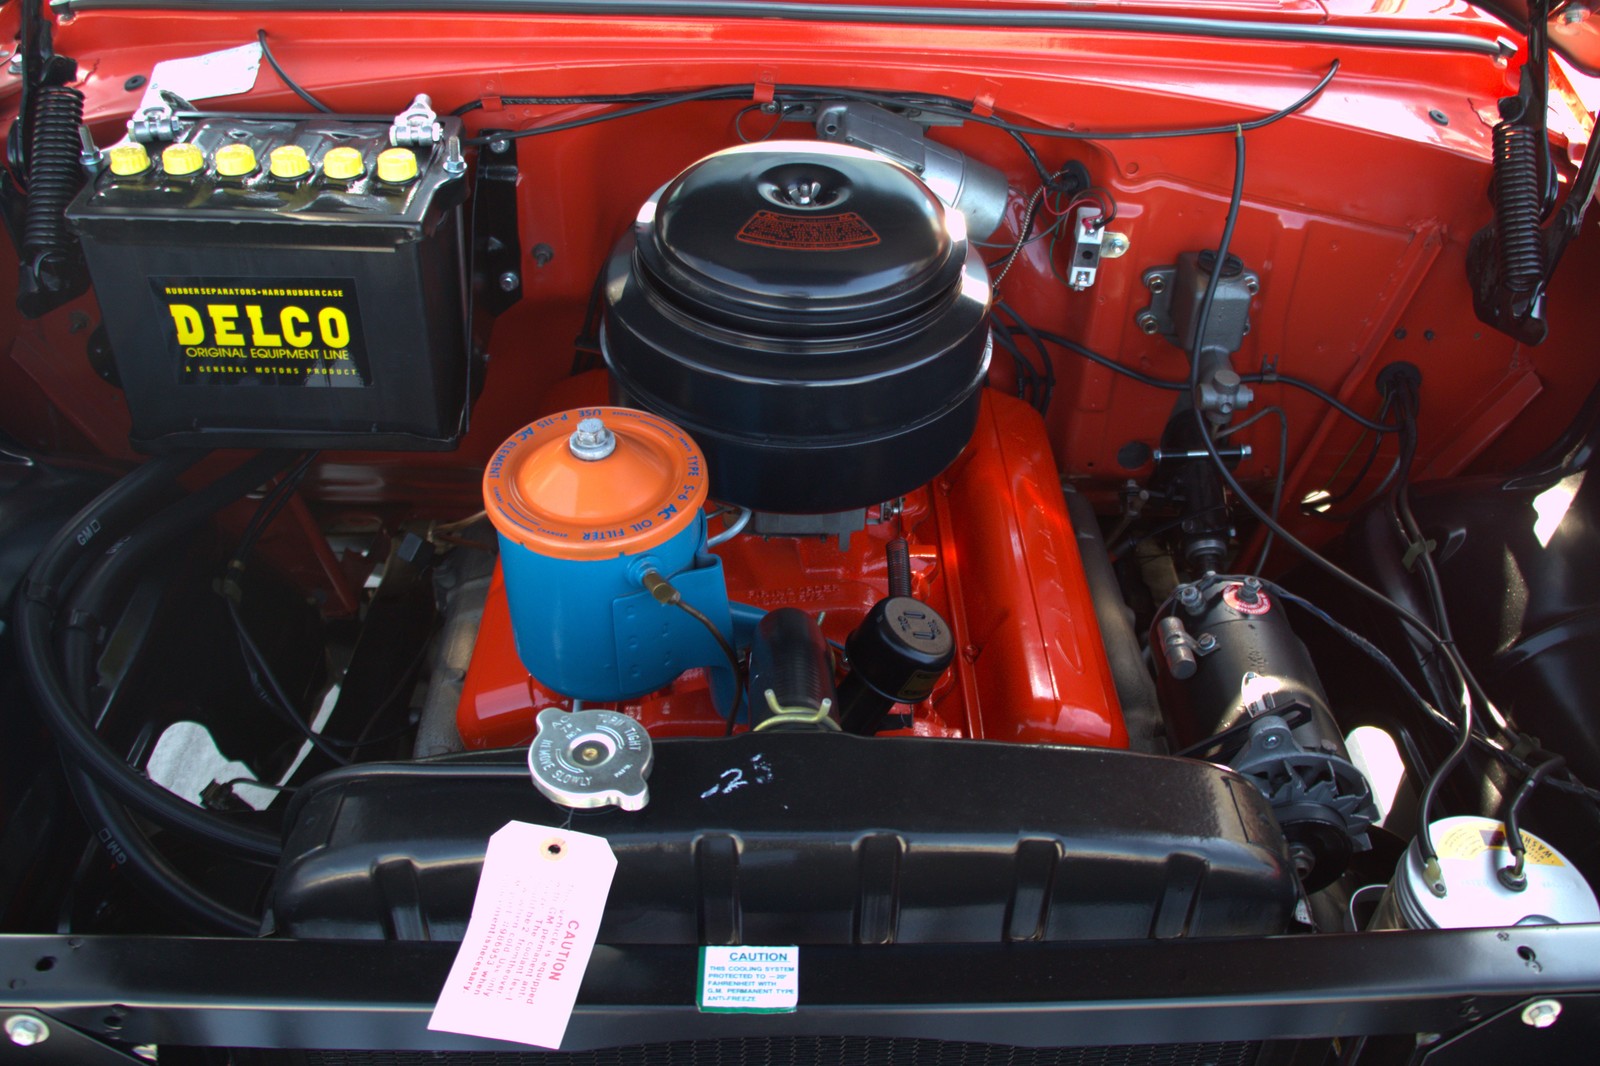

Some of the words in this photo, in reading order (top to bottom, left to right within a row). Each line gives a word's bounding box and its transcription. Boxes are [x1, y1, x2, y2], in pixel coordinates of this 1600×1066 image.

[165, 287, 199, 295] RUBBER
[200, 288, 256, 296] SEPARATORS
[262, 289, 285, 297] HARD
[286, 289, 321, 297] RUBBER
[321, 289, 344, 297] CASE
[169, 304, 350, 349] DELCO
[186, 347, 247, 358] ORIGINAL
[251, 349, 319, 359] EQUIPMENT
[323, 350, 349, 360] LINE
[255, 367, 299, 375] MOTORS
[579, 409, 602, 418] USE
[515, 428, 534, 441] AC
[489, 441, 517, 479] ELEMENT
[688, 455, 699, 476] TYPE
[678, 484, 695, 501] S-6
[658, 504, 678, 520] AC
[630, 519, 653, 533] OIL
[582, 529, 625, 541] FILTER
[624, 727, 641, 751] TIGHT
[552, 770, 592, 786] SLOWLY
[530, 918, 543, 937] The
[548, 919, 579, 981] CAUTION
[729, 952, 787, 960] CAUTION
[472, 969, 489, 996] when
[525, 960, 548, 1005] equipped
